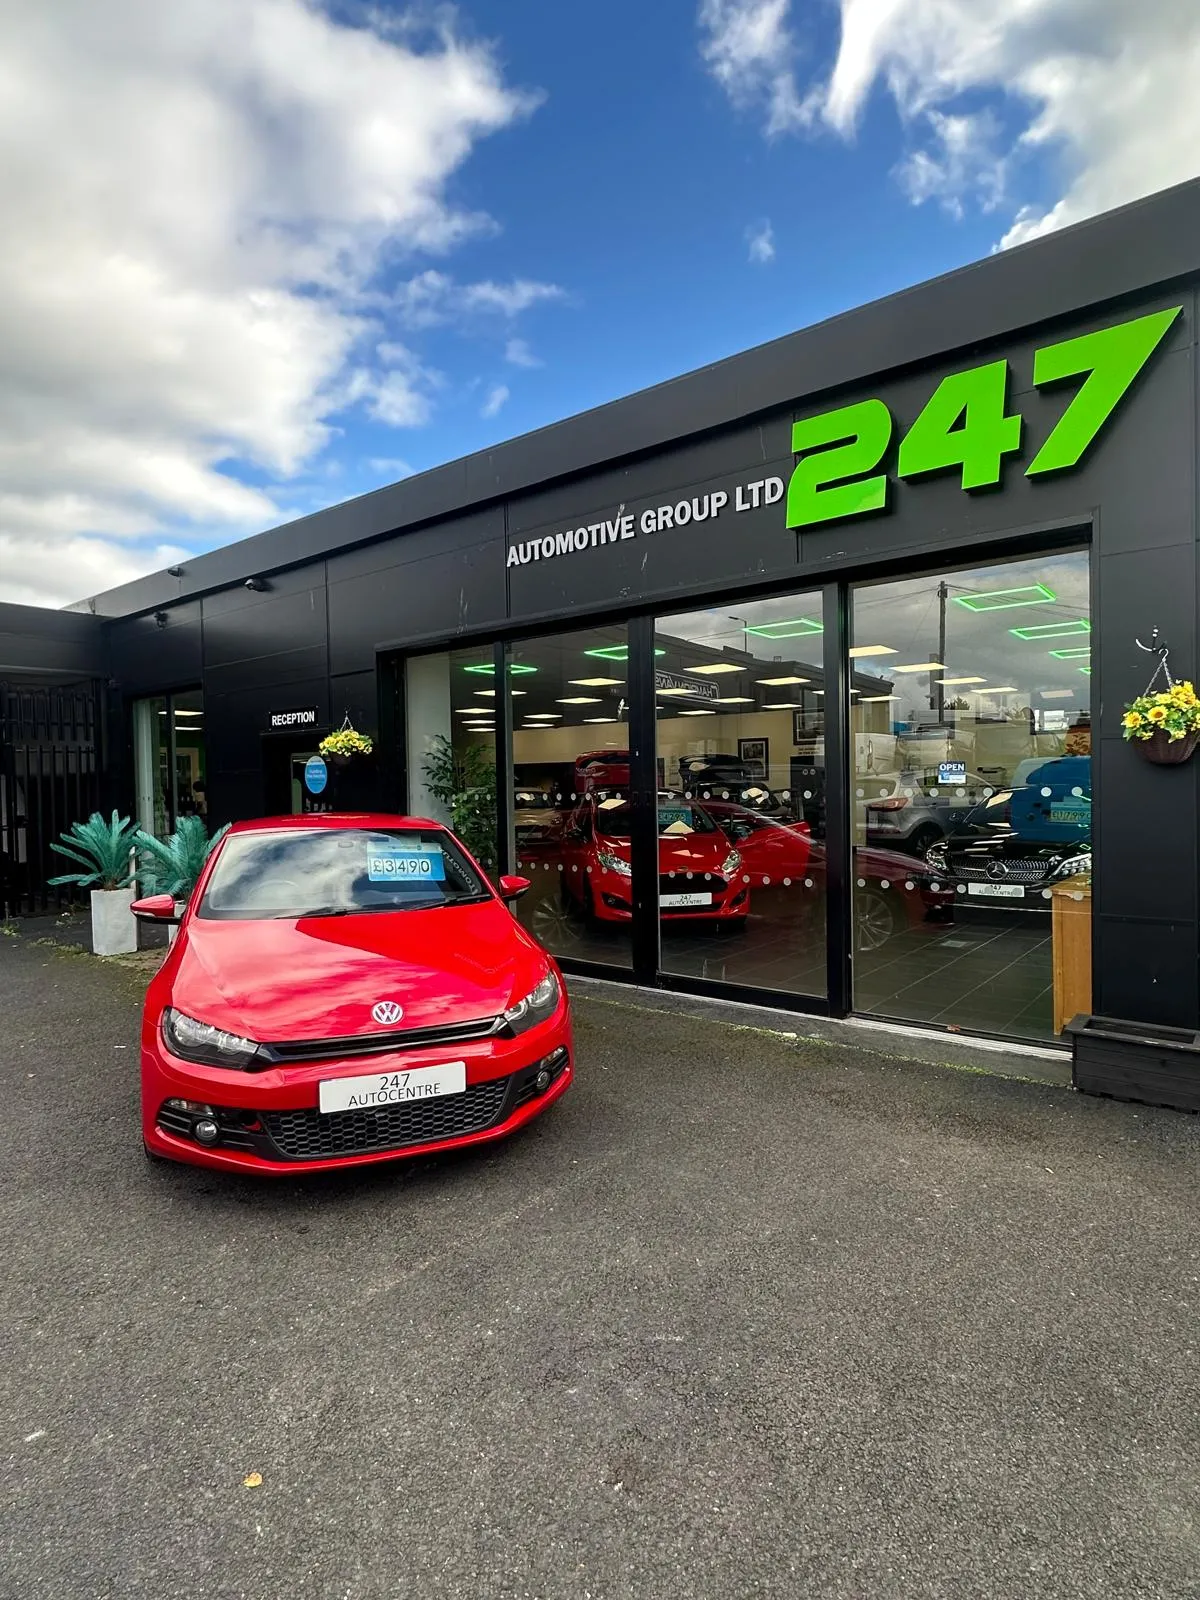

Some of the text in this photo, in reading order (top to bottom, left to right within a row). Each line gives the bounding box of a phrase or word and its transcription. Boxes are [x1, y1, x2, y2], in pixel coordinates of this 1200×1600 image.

[786, 305, 1183, 529] 247
[507, 476, 784, 567] AUTOMOTIVE GROUP LTD
[272, 710, 315, 726] RECEPTION
[940, 763, 965, 771] OPEN
[373, 860, 430, 873] £3490
[680, 894, 692, 902] 247
[379, 1072, 410, 1091] 247
[348, 1082, 441, 1107] AUTOCENTRE
